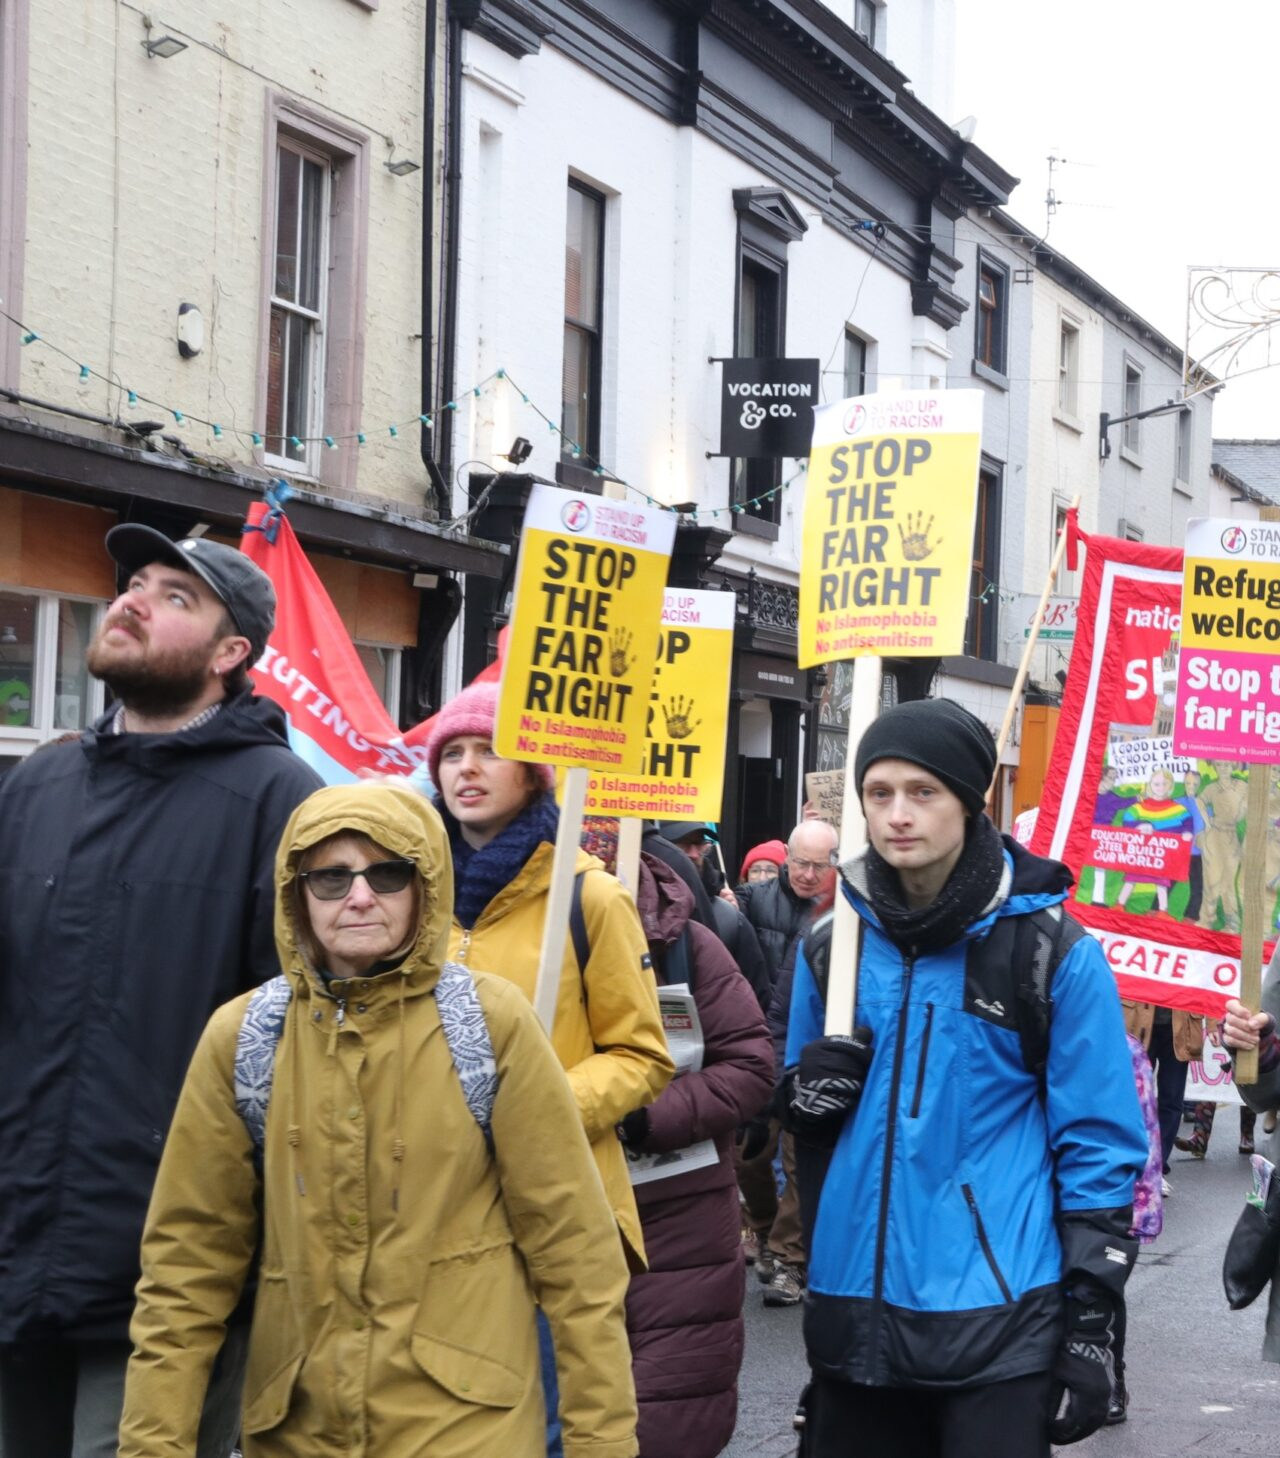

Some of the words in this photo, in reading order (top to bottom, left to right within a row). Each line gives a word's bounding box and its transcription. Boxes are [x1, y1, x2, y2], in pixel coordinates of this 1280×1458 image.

[728, 382, 812, 398] VOCATION
[739, 400, 767, 430] &
[769, 403, 797, 418] CO.
[918, 399, 938, 413] UP
[889, 414, 943, 428] RACISM
[828, 438, 932, 484] STOP
[825, 481, 897, 527] THE
[631, 514, 645, 528] UP
[611, 525, 648, 545] RACISM
[821, 524, 889, 571] FAR
[1250, 542, 1266, 556] TO
[544, 538, 636, 591] STOP
[818, 567, 942, 614] RIGHT
[540, 581, 613, 632] THE
[678, 596, 696, 610] UP
[661, 608, 701, 624] ACISM
[816, 617, 832, 635] No
[834, 611, 938, 631] Islamophobia
[531, 626, 603, 676] FAR
[815, 638, 831, 655] No
[832, 633, 934, 650] antisemitism
[1187, 656, 1260, 702] Stop
[525, 671, 633, 723] RIGHT
[1184, 699, 1232, 730] far
[520, 714, 541, 733] No
[545, 717, 627, 744] Islamophobia
[516, 735, 539, 753] No
[542, 740, 623, 765] antisemitism
[1118, 741, 1149, 755] GOOD
[1152, 740, 1173, 751] LO
[1116, 764, 1148, 779] VERY
[601, 778, 698, 797] Islamophobia
[600, 795, 696, 814] antisemitism
[1091, 829, 1145, 845] EDUCATION
[1148, 836, 1179, 850] AND
[1098, 840, 1124, 852] STEEL
[1127, 844, 1166, 857] BUILD
[1094, 849, 1116, 863] OUR
[1118, 853, 1165, 869] WORLD
[1103, 940, 1188, 979] CATE
